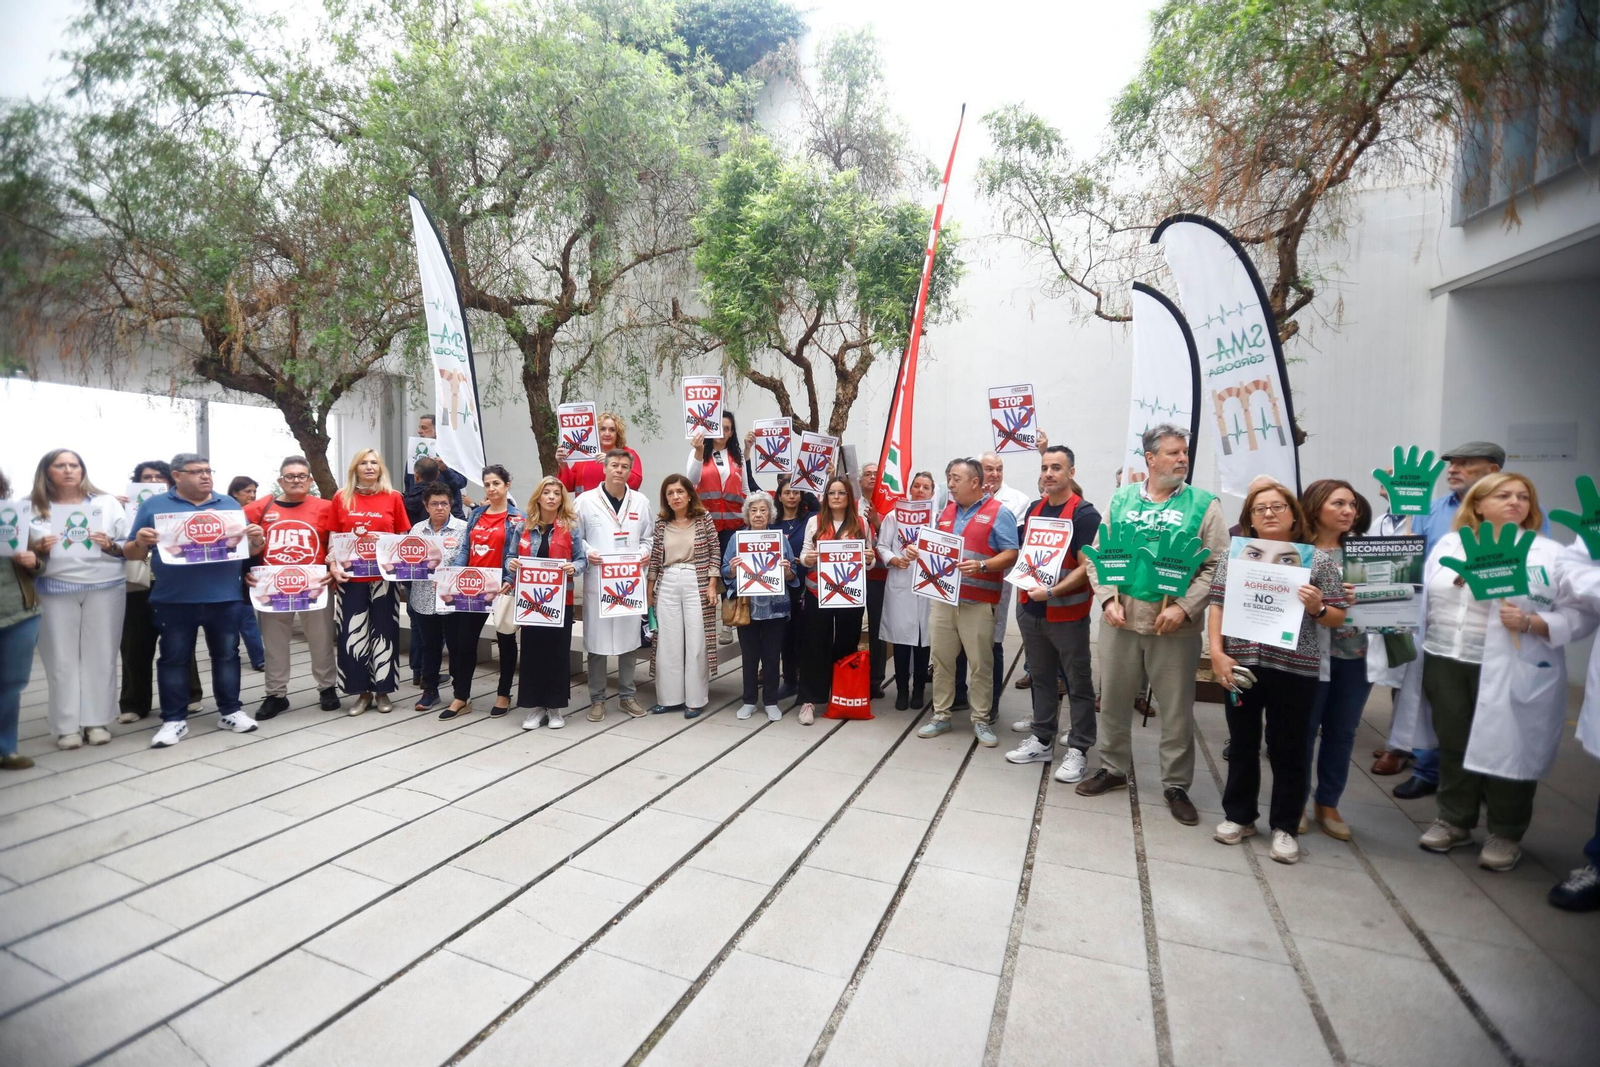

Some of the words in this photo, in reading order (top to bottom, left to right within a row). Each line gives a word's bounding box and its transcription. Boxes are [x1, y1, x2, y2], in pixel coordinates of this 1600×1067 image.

[687, 388, 718, 399] STOP
[998, 396, 1024, 408] STOP
[697, 402, 714, 418] NO
[562, 414, 590, 426] STOP
[1003, 406, 1031, 431] NO
[571, 428, 589, 444] NO
[762, 428, 783, 436] STOP
[766, 435, 788, 455] NO
[807, 444, 827, 453] STOP
[806, 453, 827, 471] NO
[897, 510, 927, 523] STOP
[189, 522, 220, 535] STOP
[268, 529, 311, 549] UGT
[1030, 531, 1064, 546] STOP
[358, 543, 376, 551] STO
[401, 546, 425, 555] STOP
[747, 542, 772, 551] STOP
[926, 542, 951, 556] STOP
[1346, 544, 1424, 553] RECOMENDADO
[752, 551, 777, 574] NO
[829, 552, 854, 561] STOP
[1034, 549, 1053, 567] NO
[929, 554, 955, 577] NO
[1152, 560, 1191, 572] AGRESIONES
[1464, 557, 1520, 570] AGRESIONES
[522, 569, 559, 583] STOP
[603, 564, 638, 577] STOP
[833, 561, 860, 584] NO
[1165, 571, 1183, 579] CUIDA
[1489, 570, 1514, 578] CUIDA
[278, 576, 305, 585] STOP
[459, 577, 482, 587] STOP
[533, 587, 554, 603] NO
[615, 580, 635, 597] NO
[1355, 589, 1405, 599] RESPETO
[1254, 593, 1274, 605] NO
[832, 695, 862, 707] CCOO
